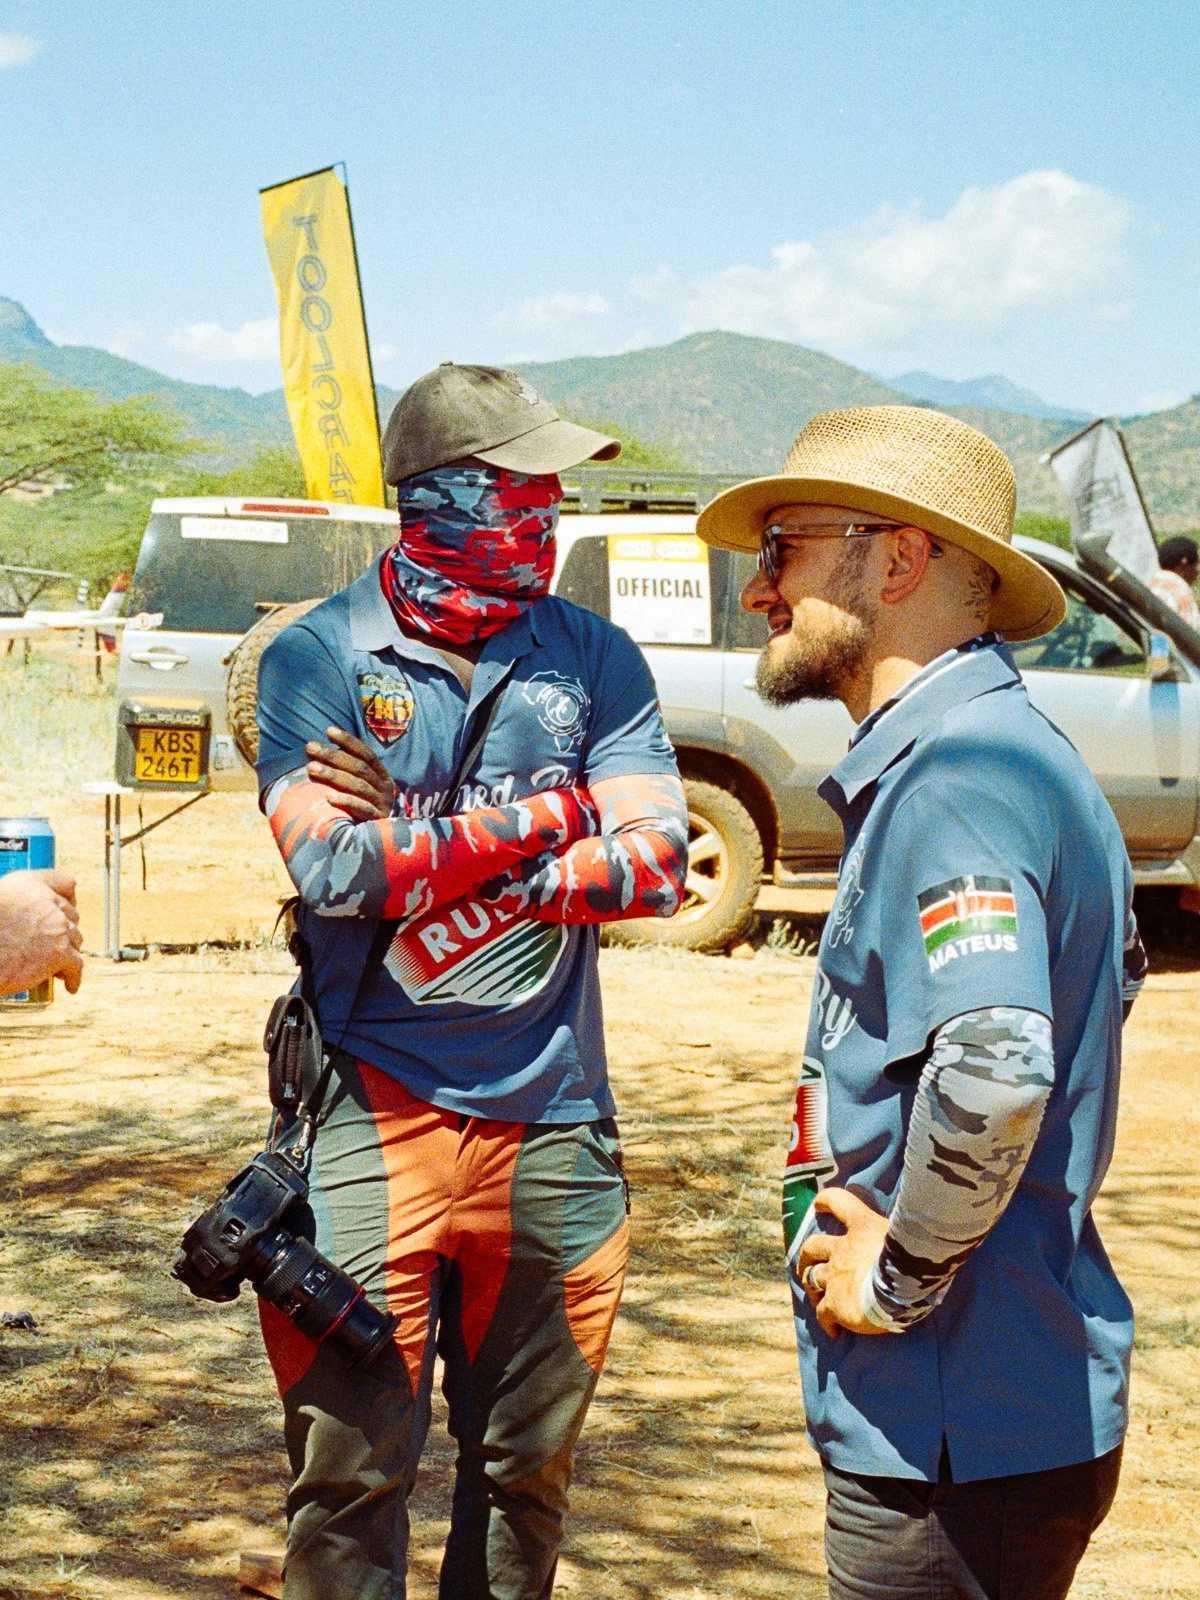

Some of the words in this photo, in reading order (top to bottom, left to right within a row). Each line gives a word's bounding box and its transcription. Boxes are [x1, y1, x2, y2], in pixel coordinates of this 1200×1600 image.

[616, 576, 704, 599] OFFICIAL
[153, 731, 195, 753] KBS
[141, 756, 194, 778] 246T
[418, 901, 514, 964] RU
[928, 933, 1018, 974] MATEUS
